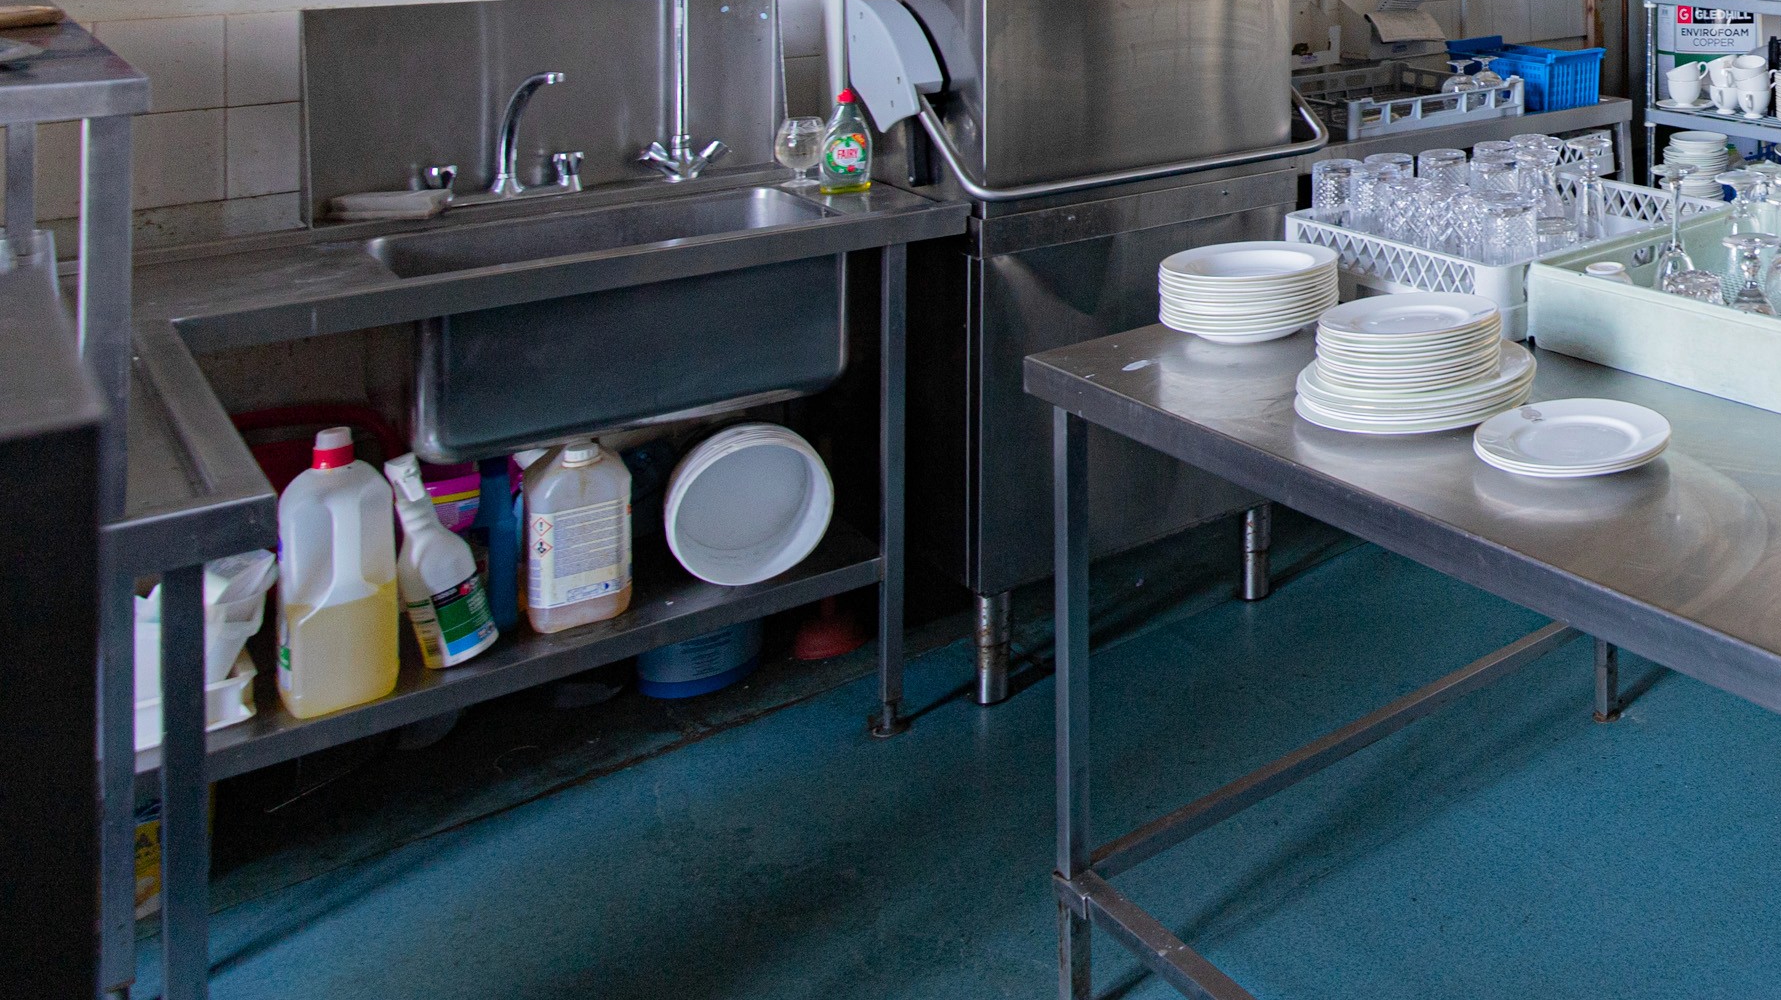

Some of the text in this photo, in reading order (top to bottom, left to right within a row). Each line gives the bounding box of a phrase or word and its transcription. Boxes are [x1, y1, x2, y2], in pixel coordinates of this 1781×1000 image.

[1679, 7, 1752, 20] G GLEDHILL
[1681, 27, 1749, 37] ENVIROFOAM
[1693, 38, 1735, 47] COPPER
[836, 147, 859, 160] FAIRY
